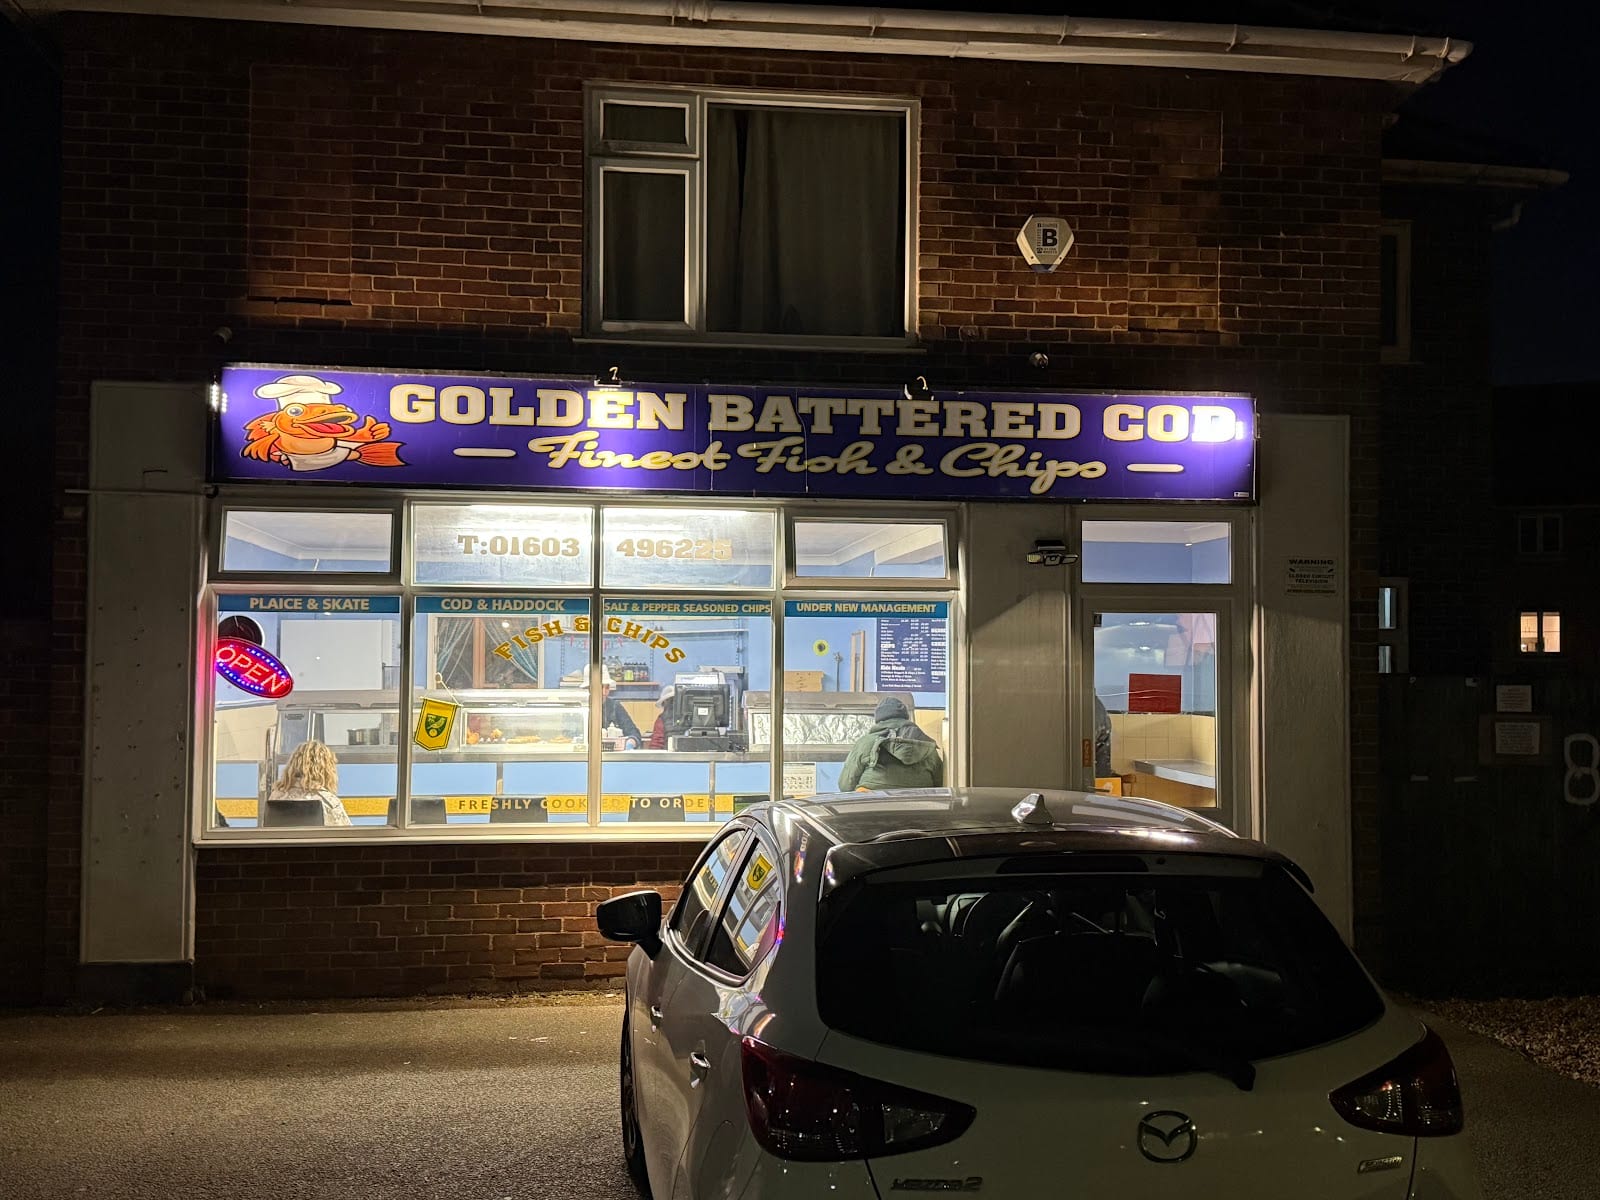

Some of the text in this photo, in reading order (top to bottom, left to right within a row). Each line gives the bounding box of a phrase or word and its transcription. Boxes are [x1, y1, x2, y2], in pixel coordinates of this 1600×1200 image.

[1042, 229, 1058, 246] B
[389, 384, 1237, 443] GOLDEN BATTERED COD
[528, 429, 1108, 495] Finest Fish & Chips
[457, 533, 732, 560] T:01603 496225
[249, 597, 370, 611] PLAICE & SKATE
[440, 598, 566, 612] COD & HADDOCK
[603, 602, 771, 614] SALT & PEPPER SEASONED CHIPS
[796, 602, 937, 613] UNDER NEW MANAGEMENT
[492, 616, 687, 665] FISH & CHIPS
[215, 646, 286, 692] OPEN
[457, 799, 531, 811] FRESHLY
[630, 798, 651, 809] TO
[660, 798, 715, 810] ORDER
